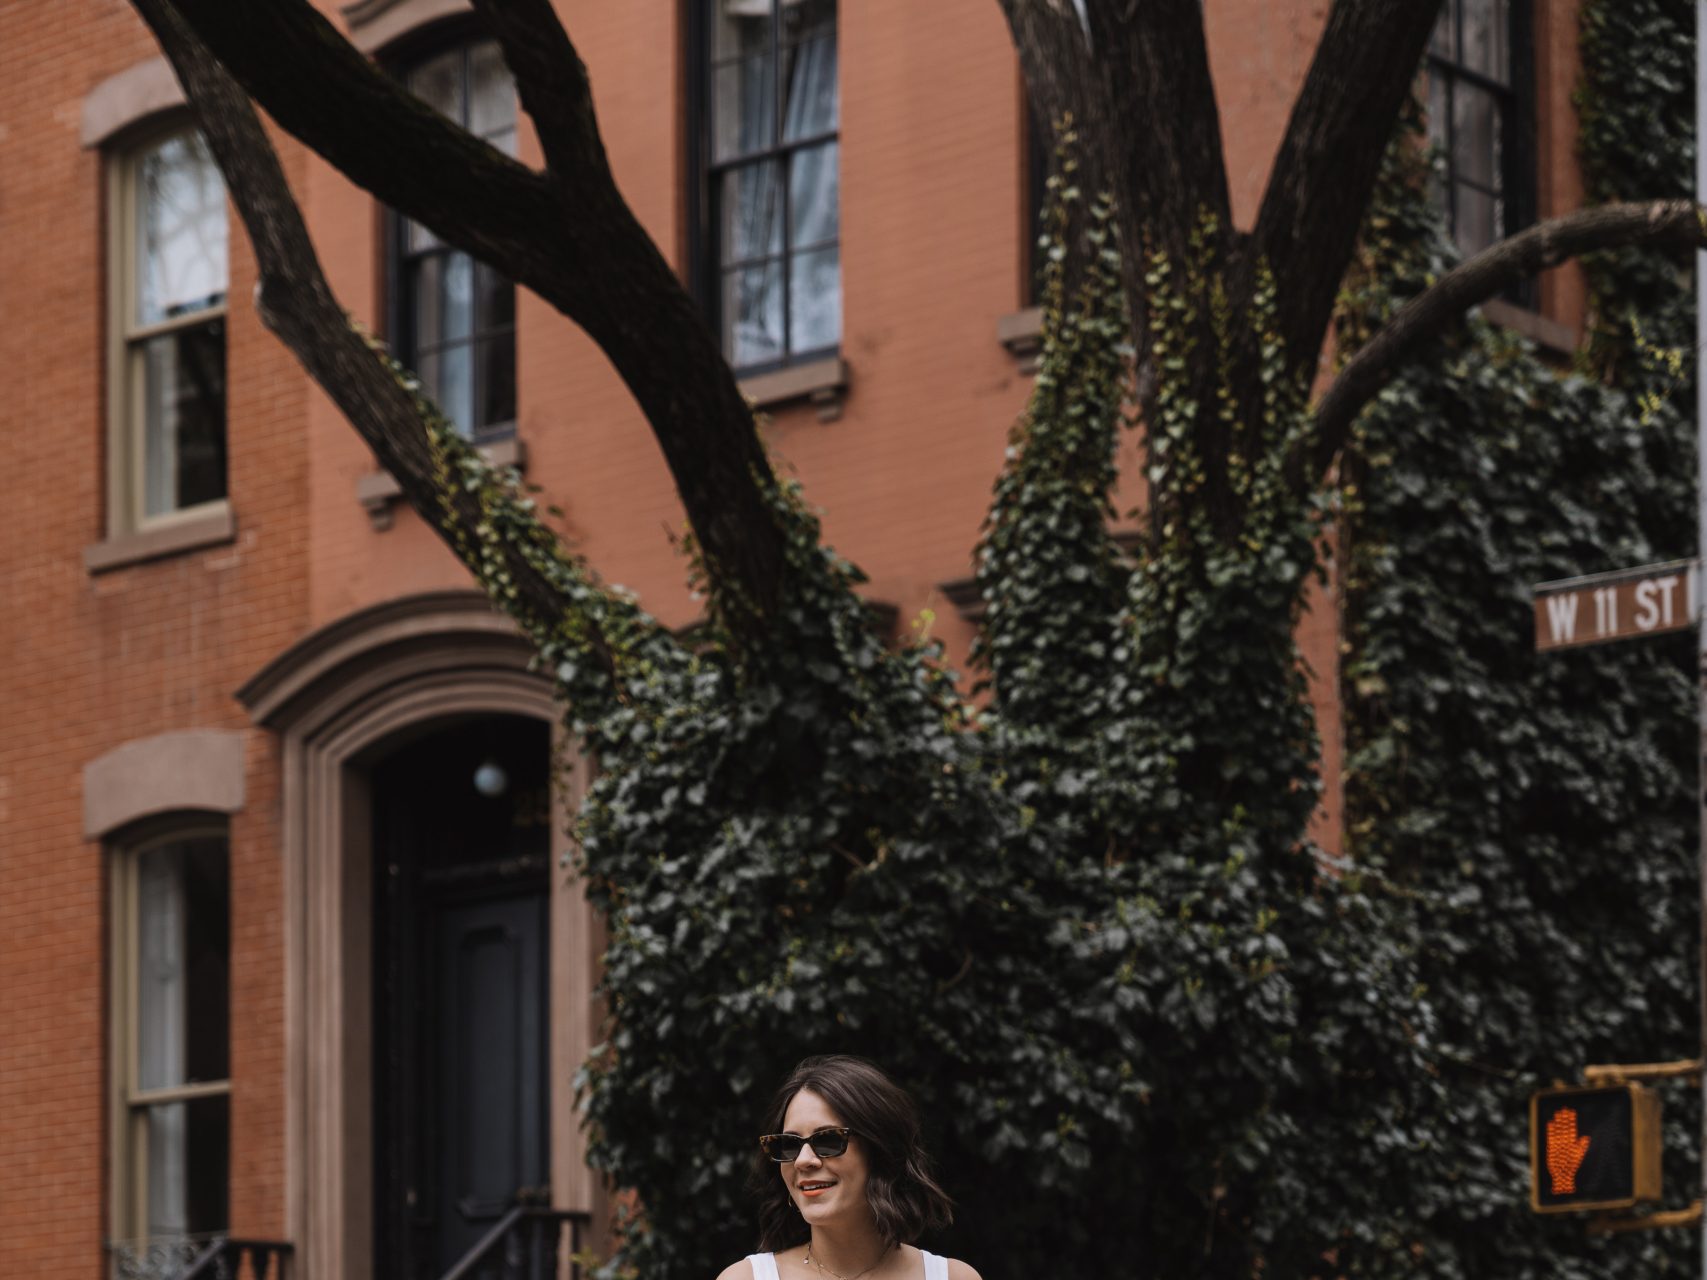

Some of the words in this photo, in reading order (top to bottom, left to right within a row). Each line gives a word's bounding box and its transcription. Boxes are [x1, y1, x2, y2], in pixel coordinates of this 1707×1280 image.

[1546, 593, 1578, 642] W
[1594, 587, 1617, 637] 11
[1634, 577, 1678, 631] ST
